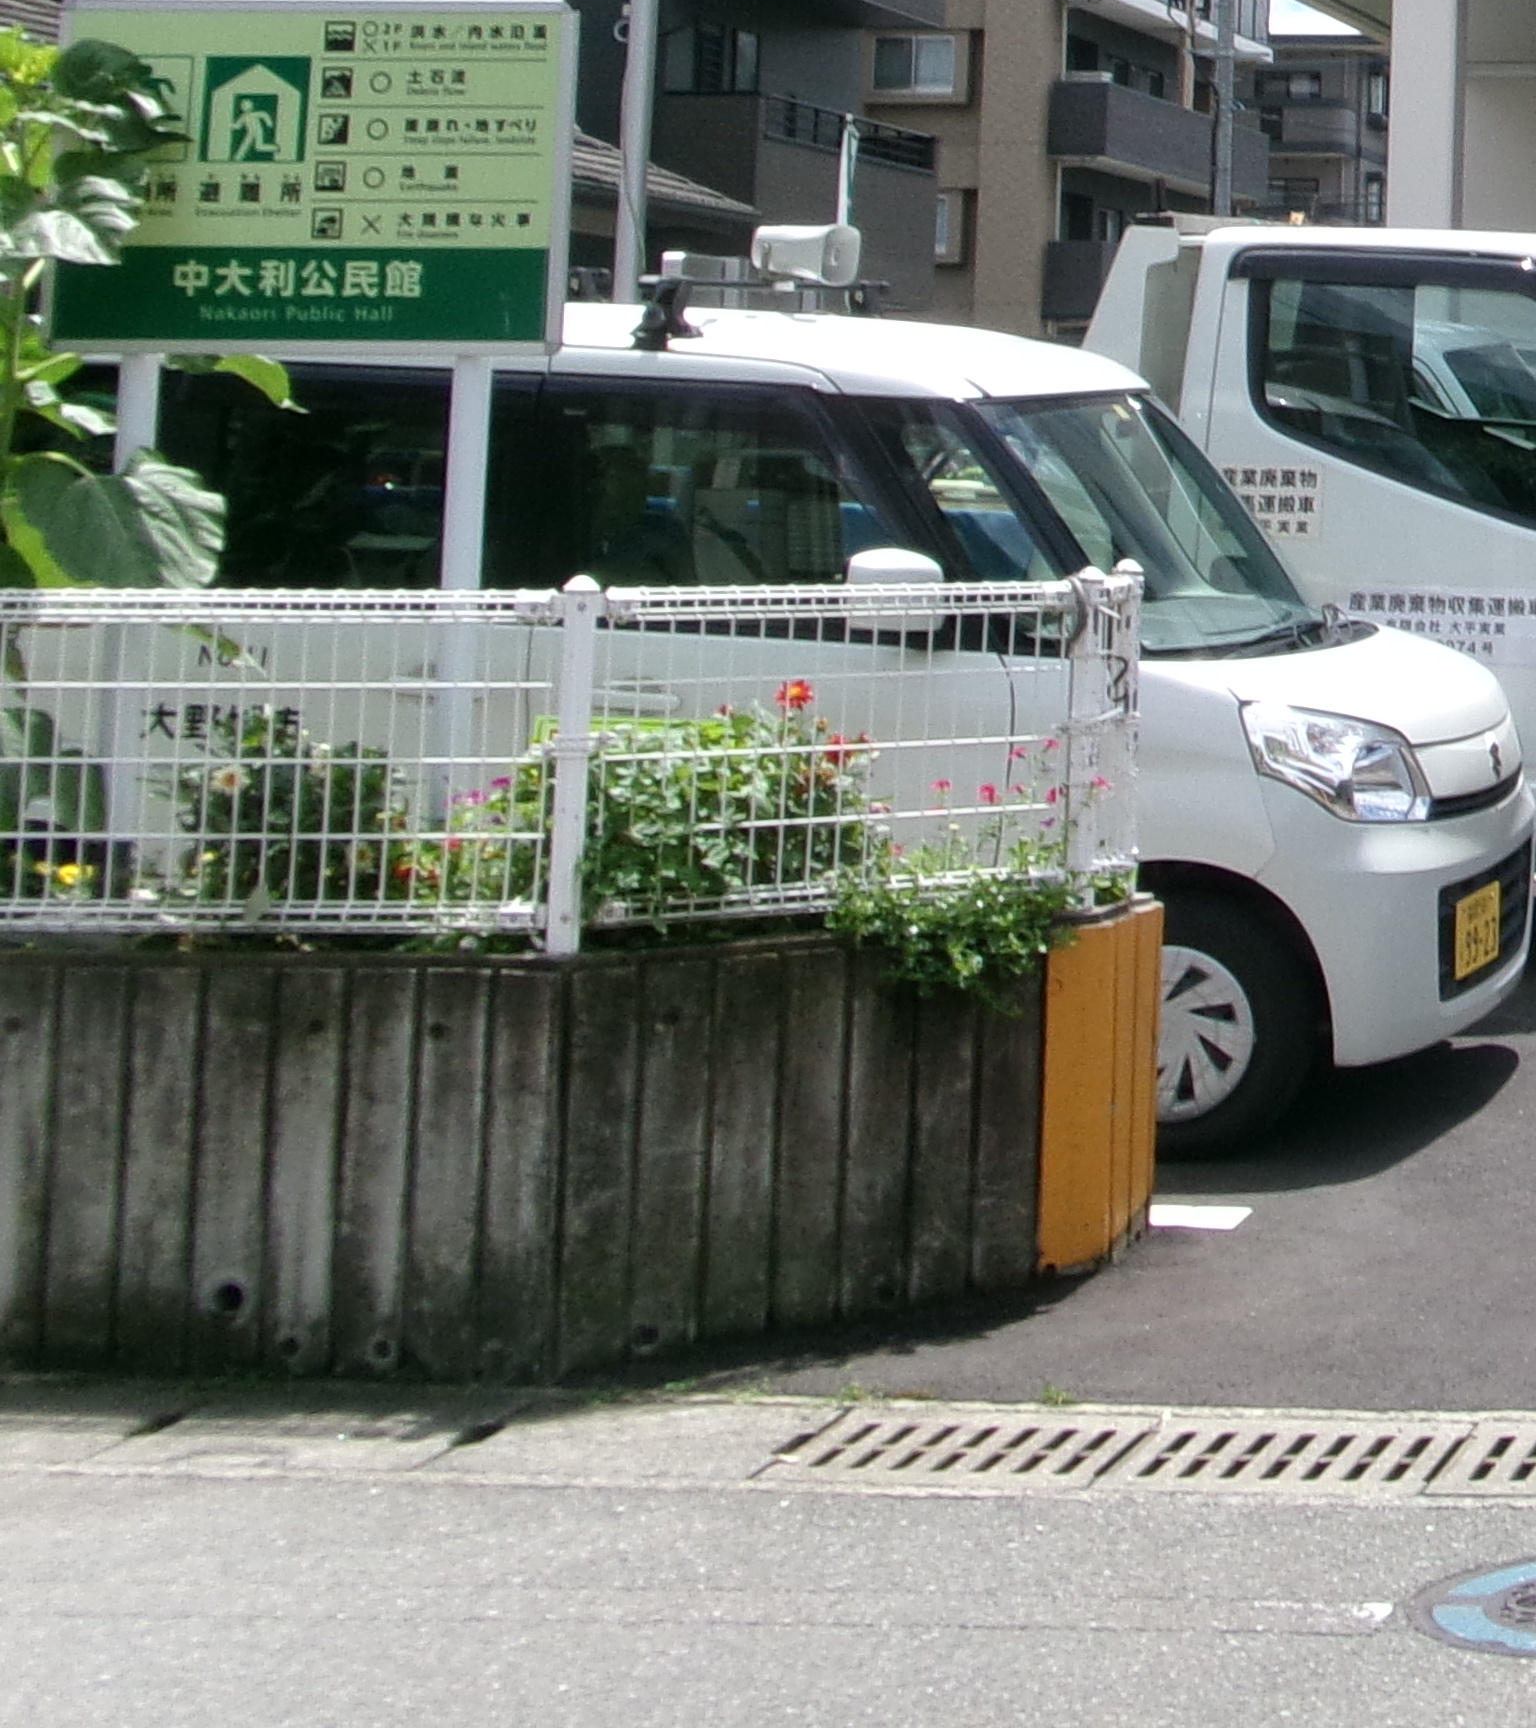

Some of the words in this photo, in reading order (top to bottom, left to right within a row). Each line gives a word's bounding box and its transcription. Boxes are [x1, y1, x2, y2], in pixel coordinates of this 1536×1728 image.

[200, 181, 301, 203] 避難所
[173, 259, 423, 298] 中大利公民館
[201, 304, 276, 322] Nakaori
[286, 303, 345, 323] Public
[355, 304, 394, 322] Hall
